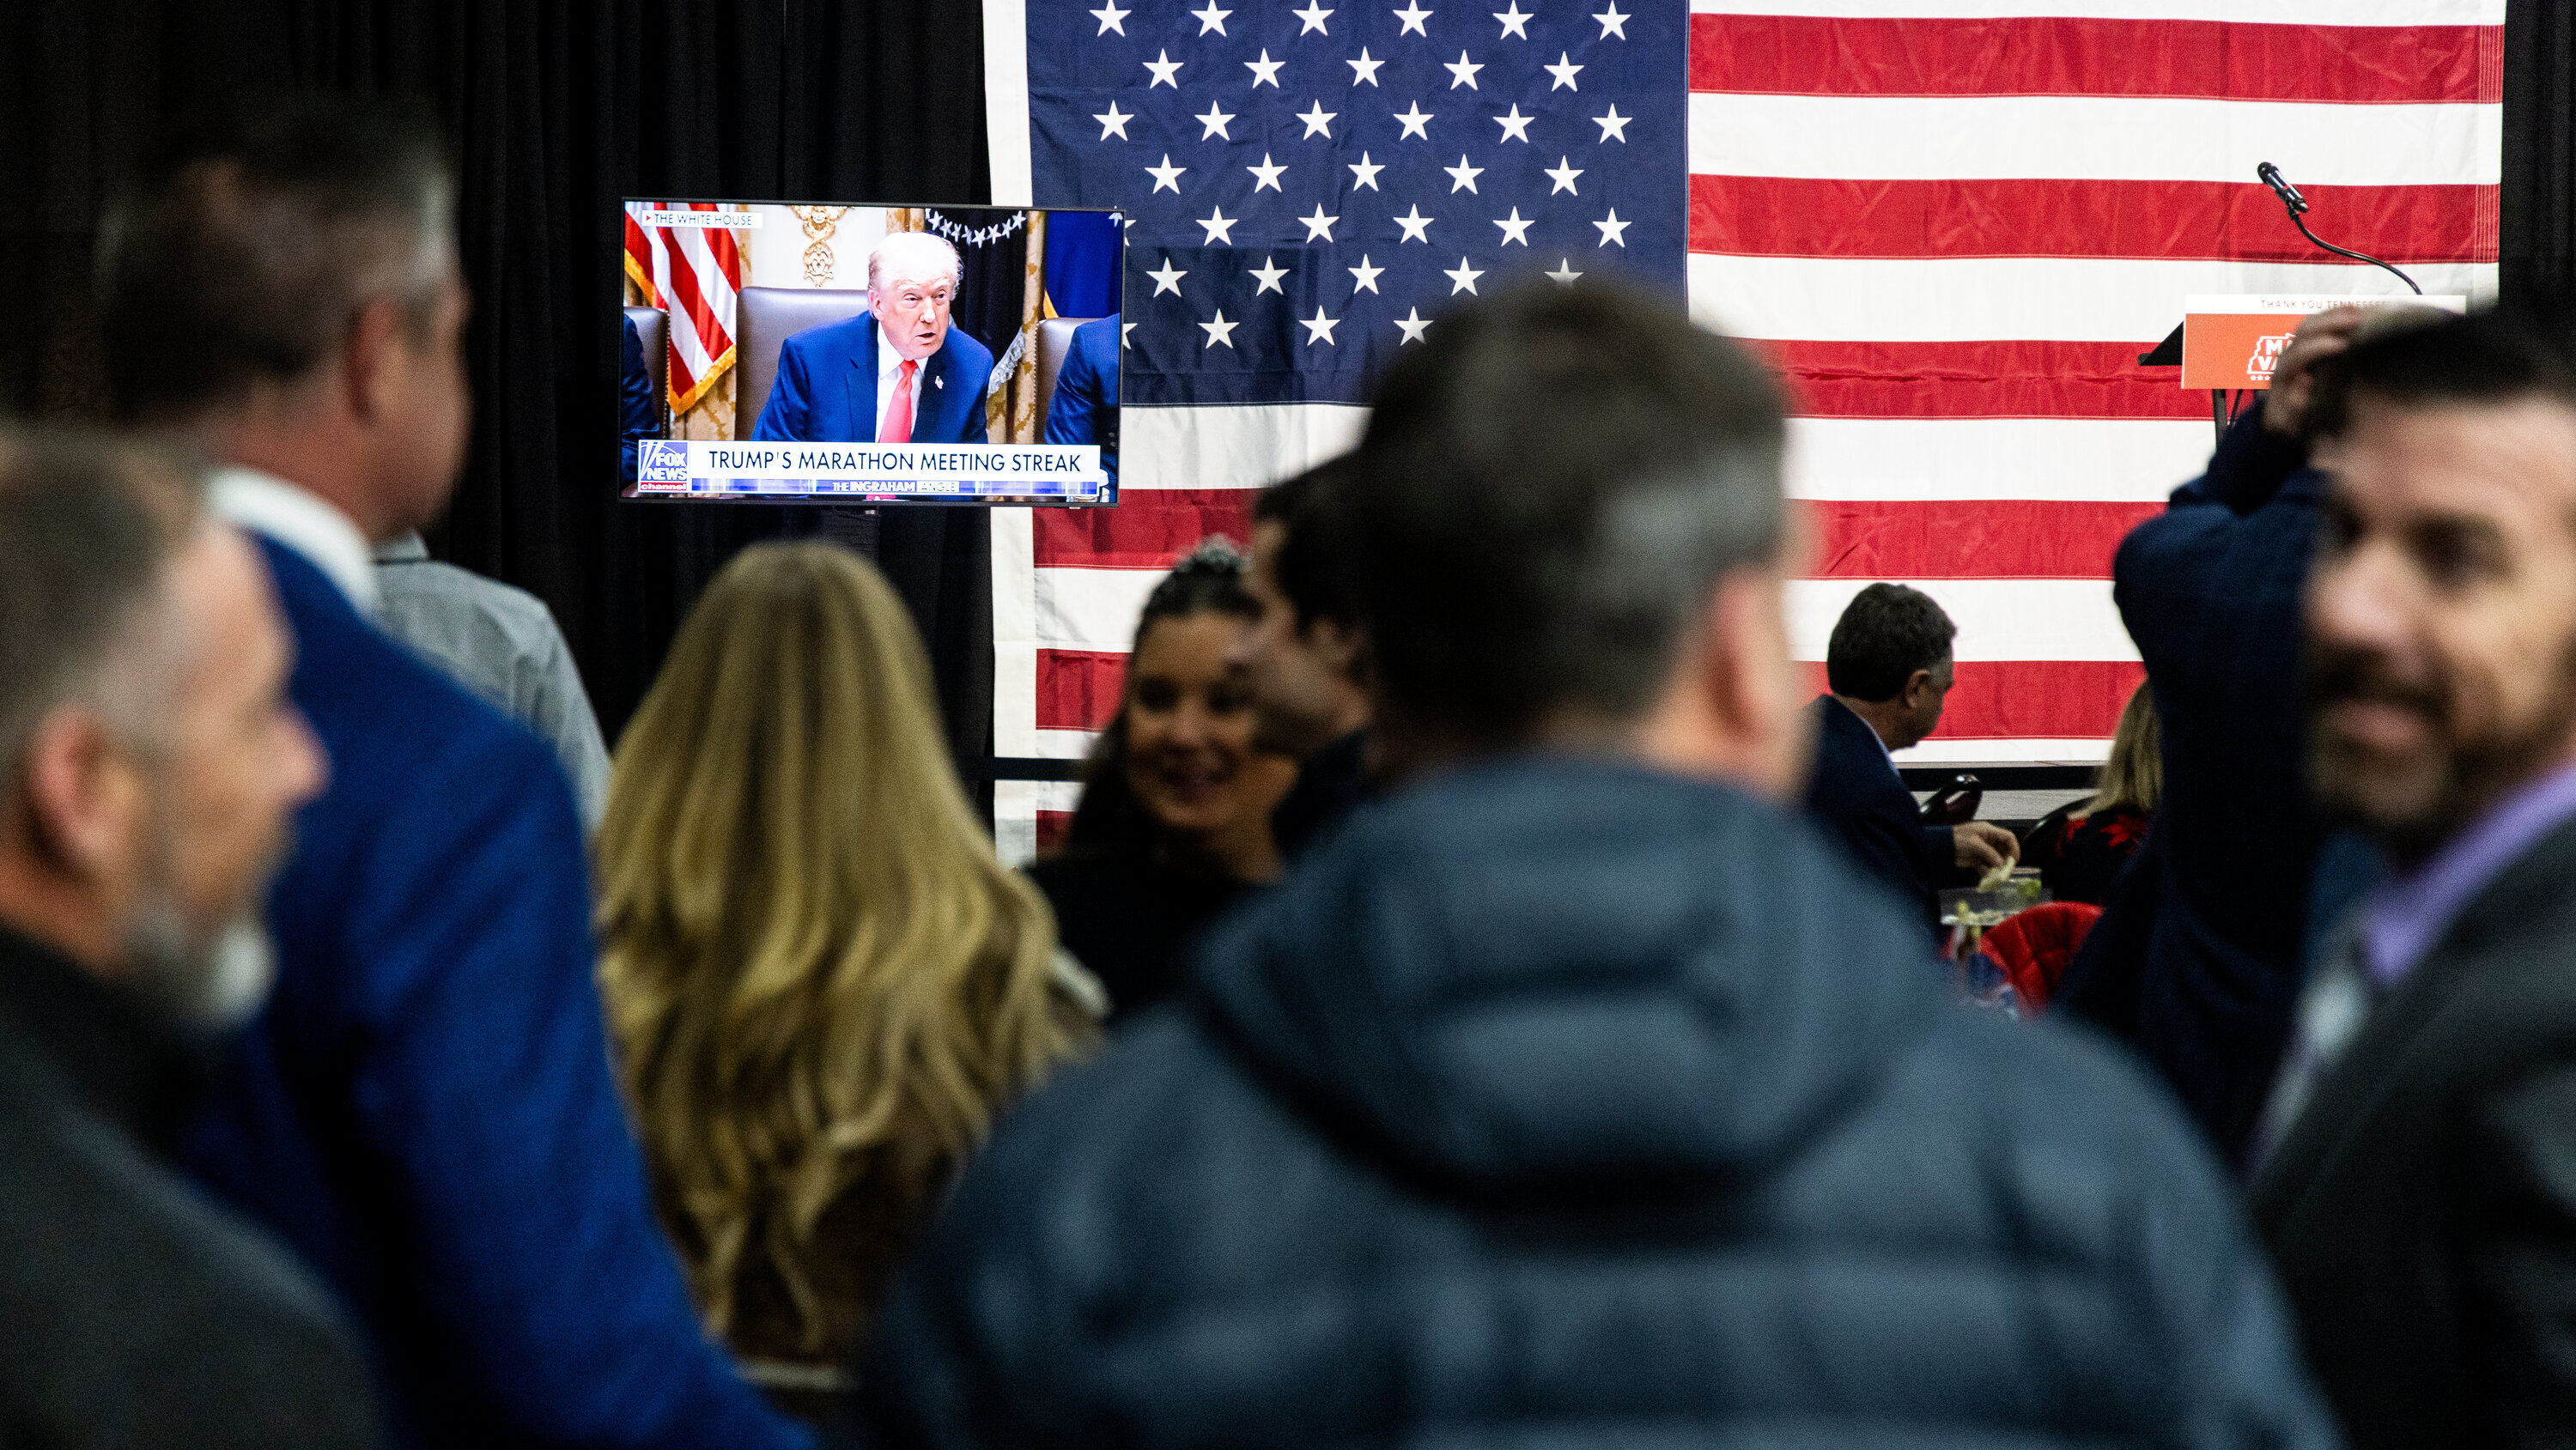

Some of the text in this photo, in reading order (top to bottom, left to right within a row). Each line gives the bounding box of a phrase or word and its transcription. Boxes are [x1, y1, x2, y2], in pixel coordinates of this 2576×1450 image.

[654, 214, 752, 226] THE WHITE HOUSE
[2261, 300, 2296, 309] THANK
[2301, 300, 2323, 309] YOU
[655, 452, 686, 467] FOX
[708, 451, 1081, 471] TRUMP'S MARATHON MEETING STREAK
[647, 467, 687, 481] NEWS
[832, 482, 849, 492] THE
[850, 481, 915, 492] INGRAHAM
